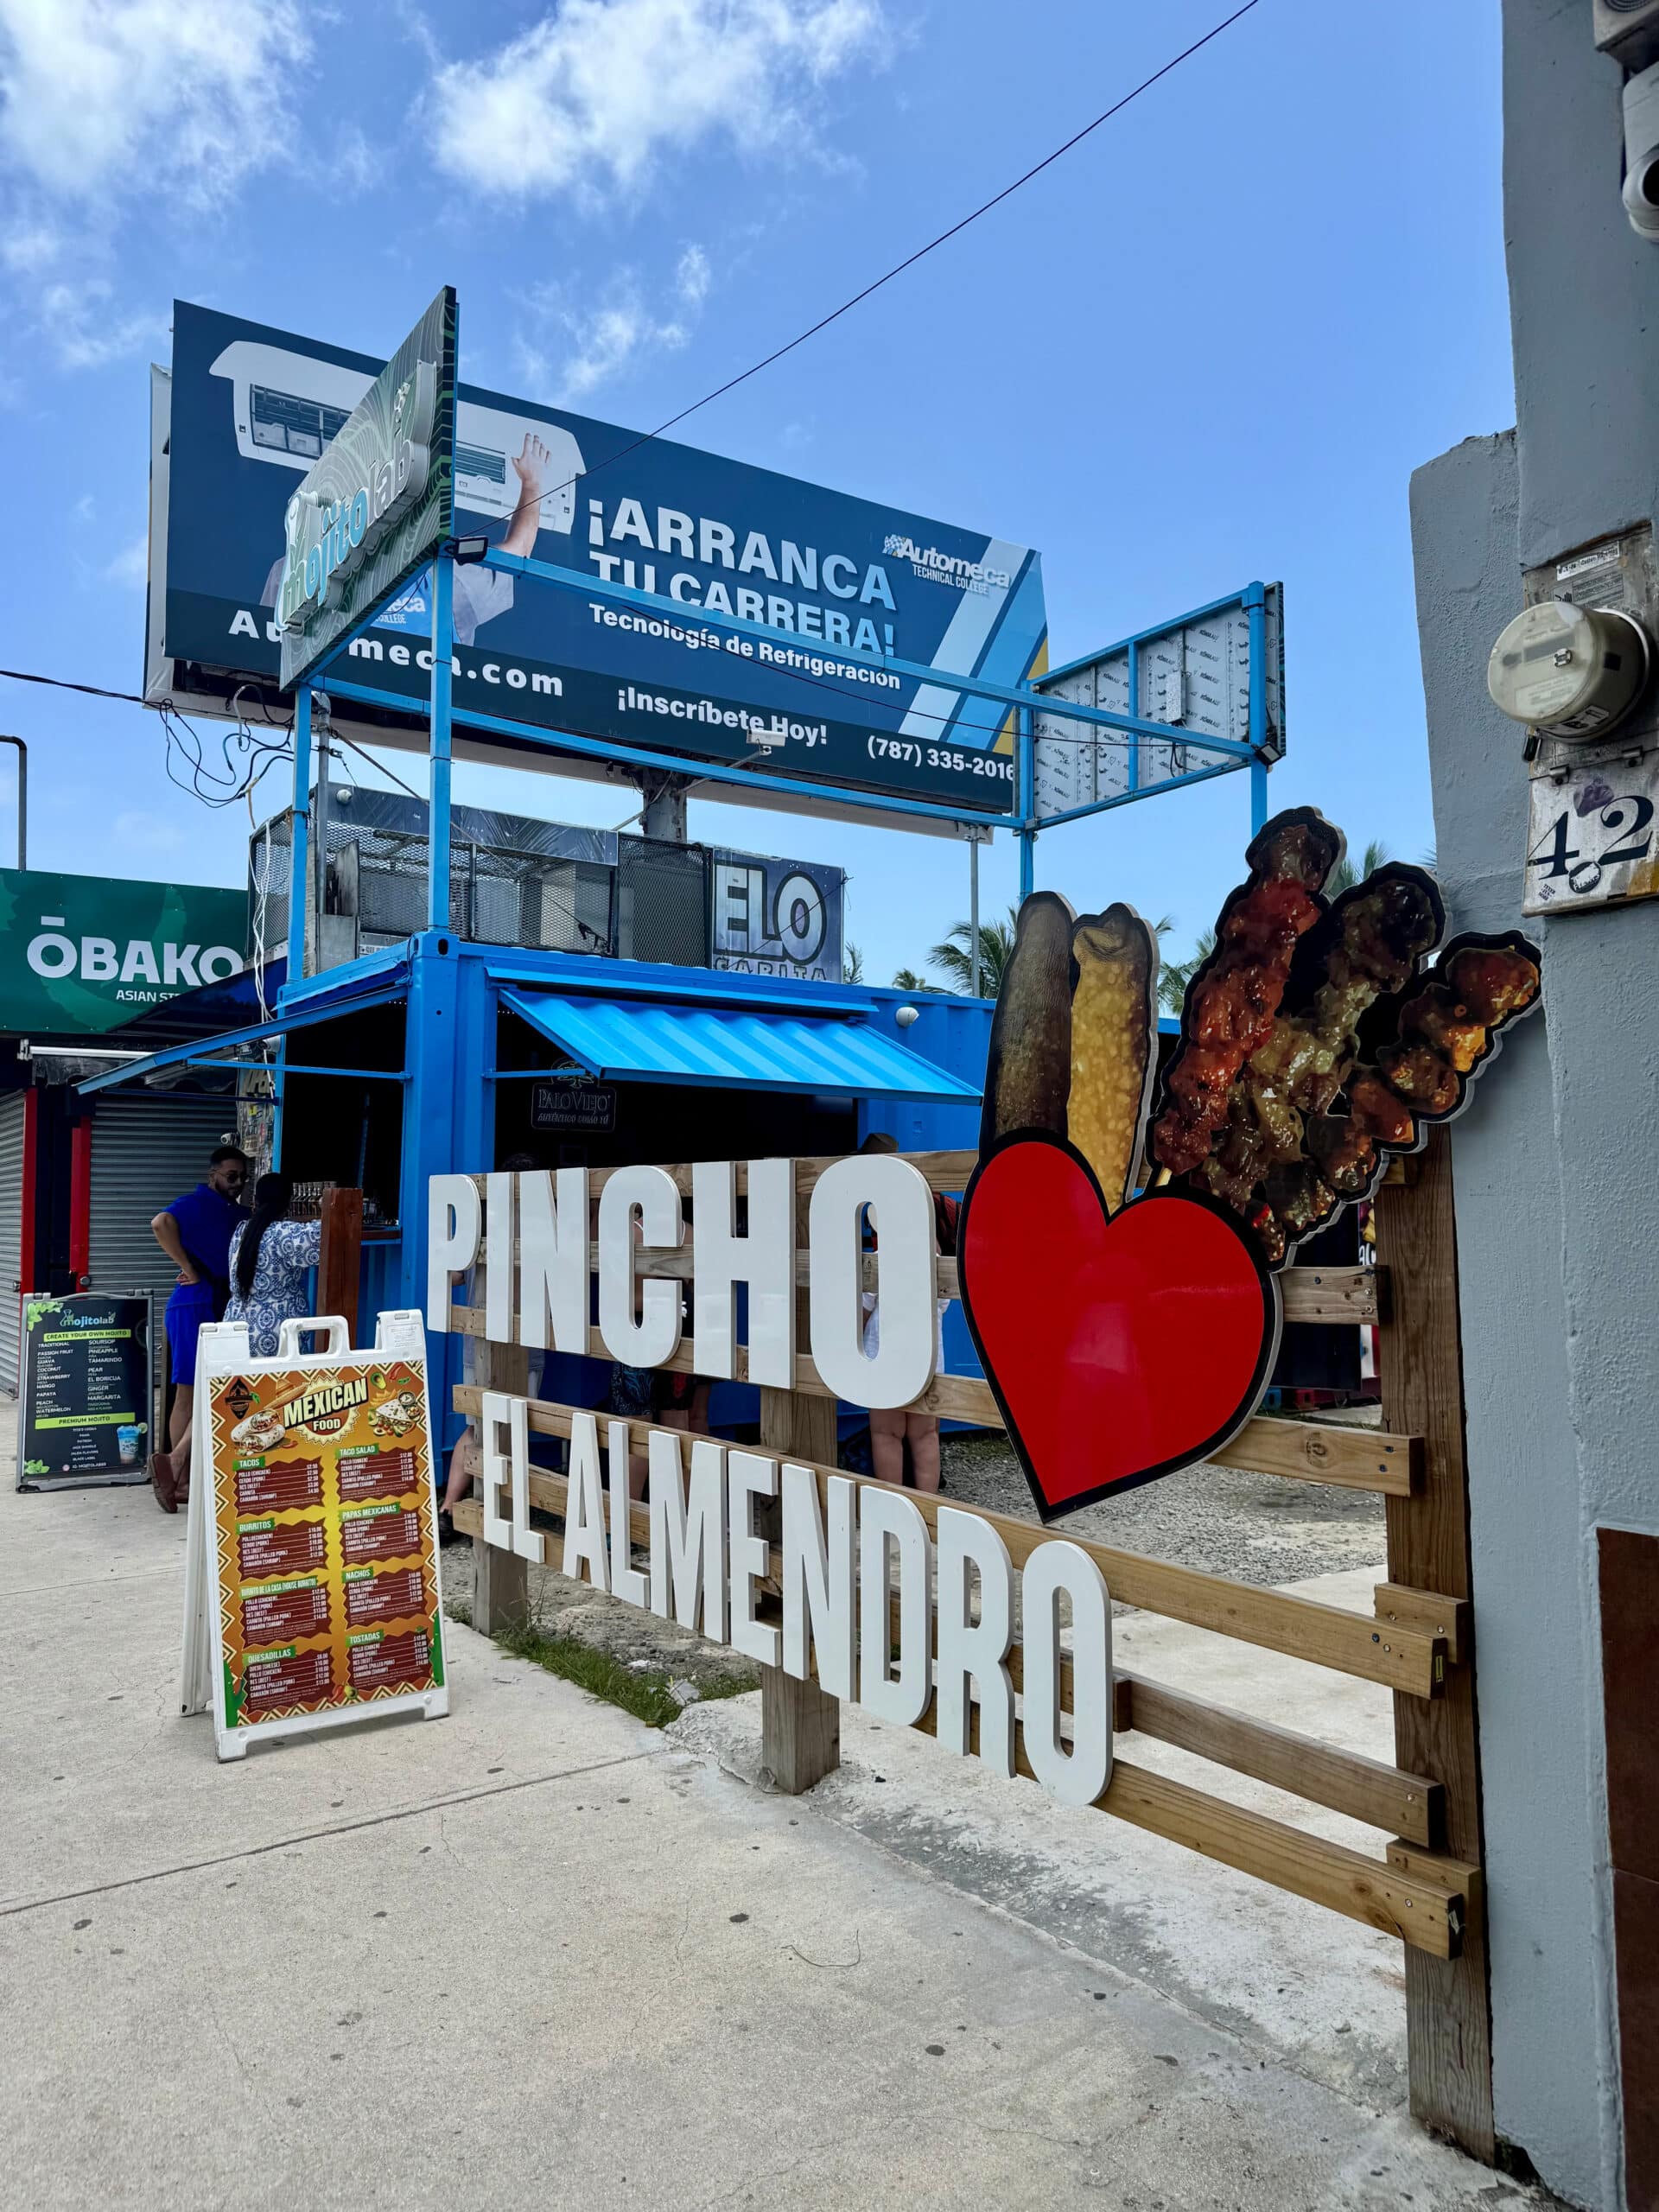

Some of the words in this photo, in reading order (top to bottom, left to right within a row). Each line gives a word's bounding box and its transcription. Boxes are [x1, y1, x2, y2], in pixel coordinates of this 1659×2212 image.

[589, 498, 897, 610] ¡ARRANCA
[898, 537, 1009, 588] Automeca
[912, 563, 954, 586] TECHNICAL
[956, 574, 989, 595] COLLEGE
[589, 551, 655, 594] TU
[670, 573, 893, 657] CARRERA!
[589, 603, 720, 650] Tecnología
[726, 636, 753, 657] de
[760, 643, 900, 690] Refrigeración
[618, 686, 765, 731] ¡Inscríbete
[772, 715, 827, 747] Hoy!
[868, 735, 922, 767] (787)
[116, 989, 156, 1002] ASIAN
[427, 1154, 938, 1409] PINCHO
[283, 1377, 368, 1428] MEXICAN
[313, 1418, 340, 1431] FOOD
[239, 1459, 259, 1467] TACOS
[356, 1446, 375, 1454] SALAD
[239, 1521, 271, 1532] BURRITOS
[342, 1510, 361, 1519] PAPAS
[363, 1505, 396, 1516] MEXICANAS
[346, 1569, 370, 1579] NACHOS
[482, 1392, 544, 1565] EL
[563, 1412, 1112, 1806] ALMENDRO
[350, 1631, 380, 1644] TOSTADAS
[248, 1649, 291, 1663] QUESADILLAS
